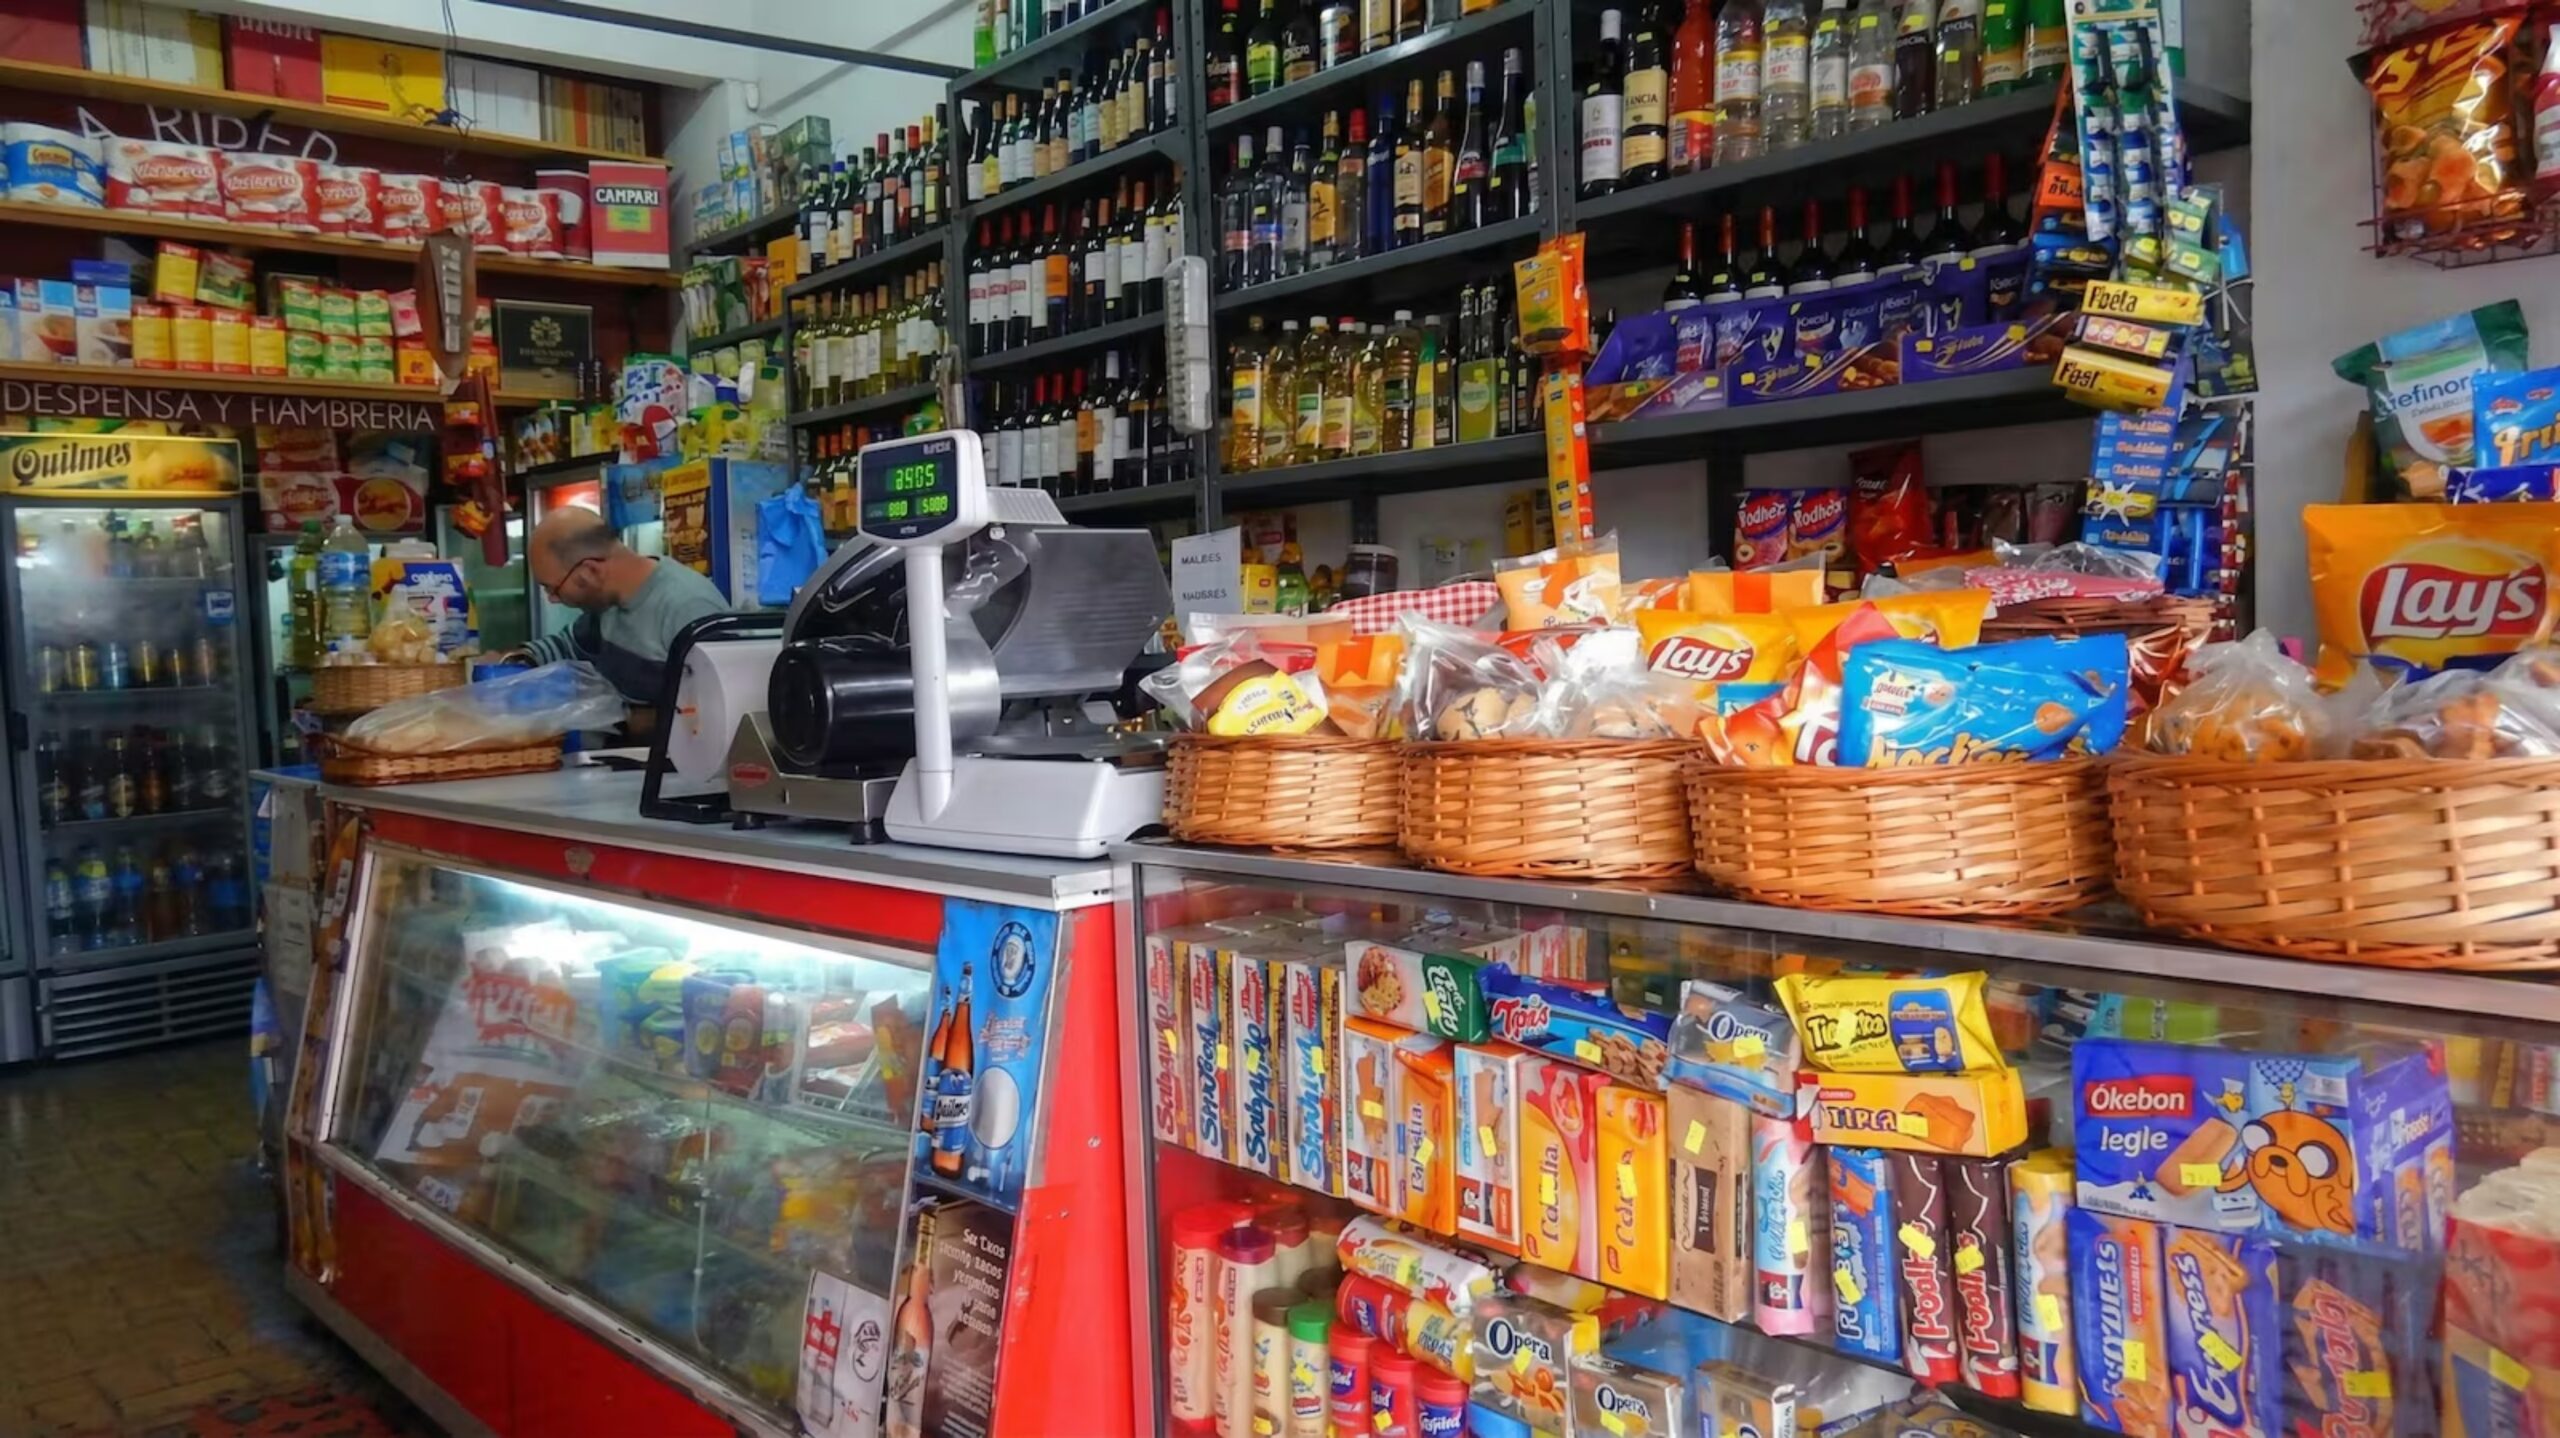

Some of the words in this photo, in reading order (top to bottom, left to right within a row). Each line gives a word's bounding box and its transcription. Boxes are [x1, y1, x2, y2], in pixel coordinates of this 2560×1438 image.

[595, 187, 659, 206] CAMPARI
[3, 380, 201, 422] DESPENSA
[214, 397, 233, 424] Y
[251, 399, 436, 431] FIAMBRERIA
[12, 441, 132, 487] Quilmes
[1486, 1318, 1551, 1360] Opera
[1595, 1384, 1651, 1419] Opera
